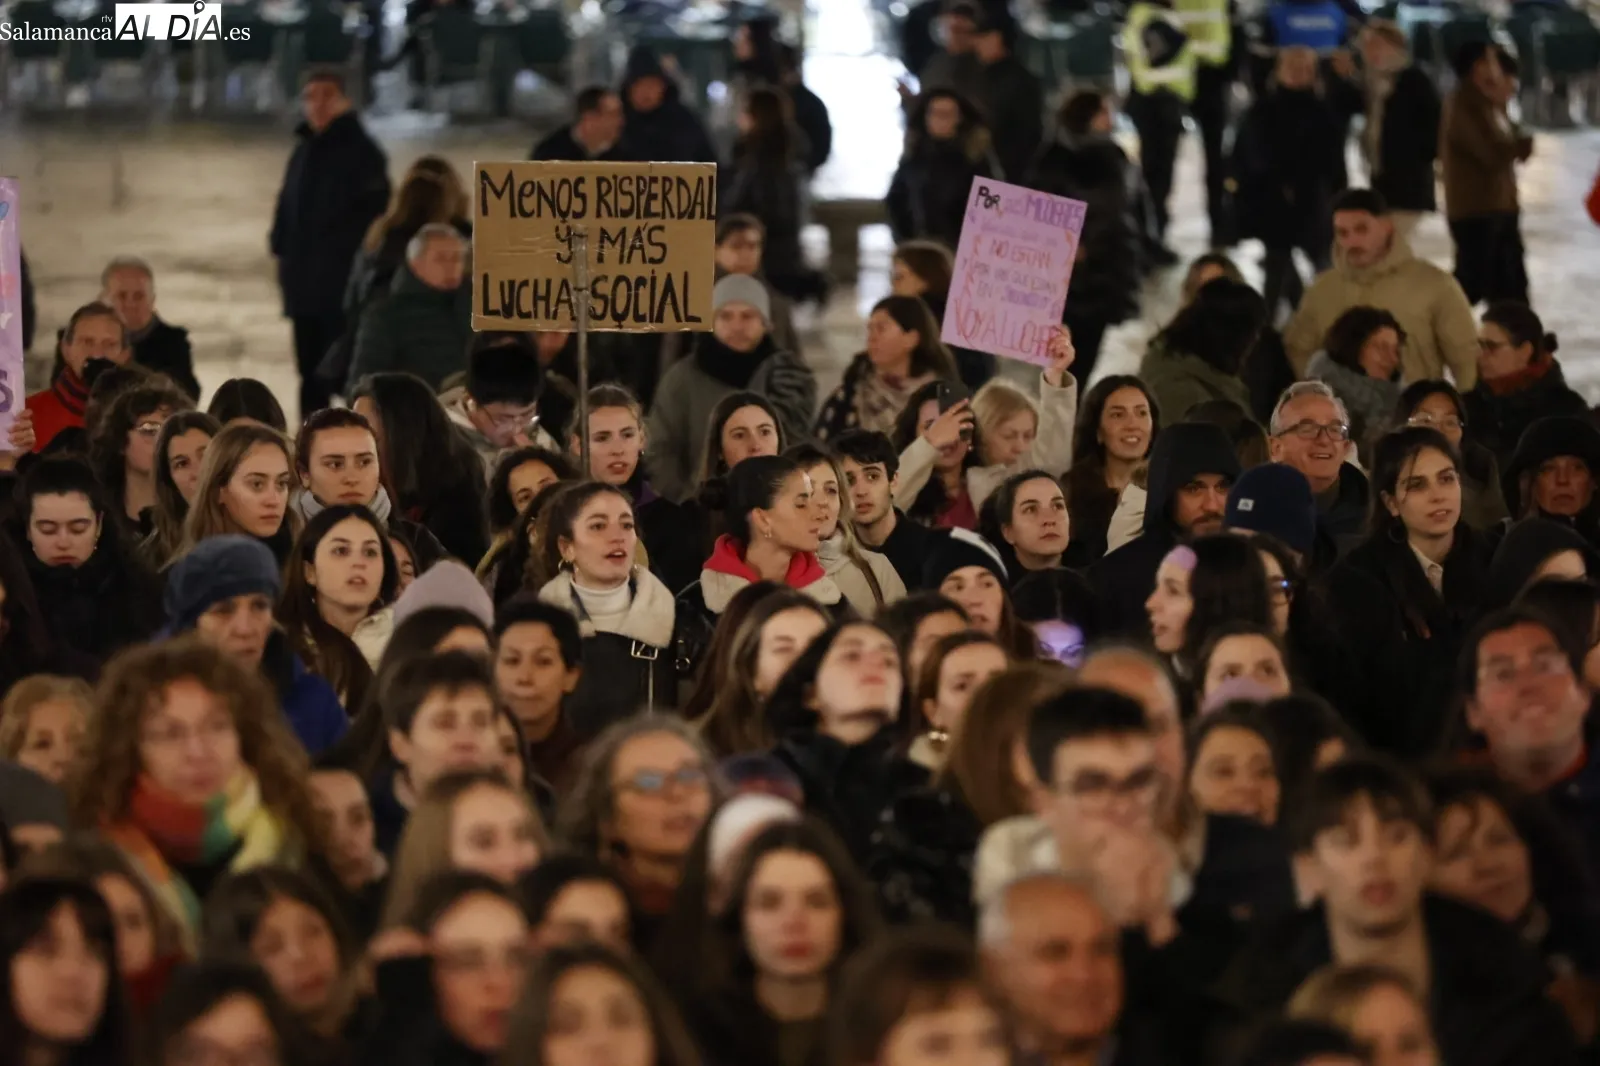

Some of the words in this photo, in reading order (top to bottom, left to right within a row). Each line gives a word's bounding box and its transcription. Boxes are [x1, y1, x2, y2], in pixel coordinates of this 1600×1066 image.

[595, 174, 716, 220] RISPERDAL
[596, 222, 668, 265] MÁS
[482, 273, 577, 320] LUCHA
[588, 269, 702, 329] SOCIAL
